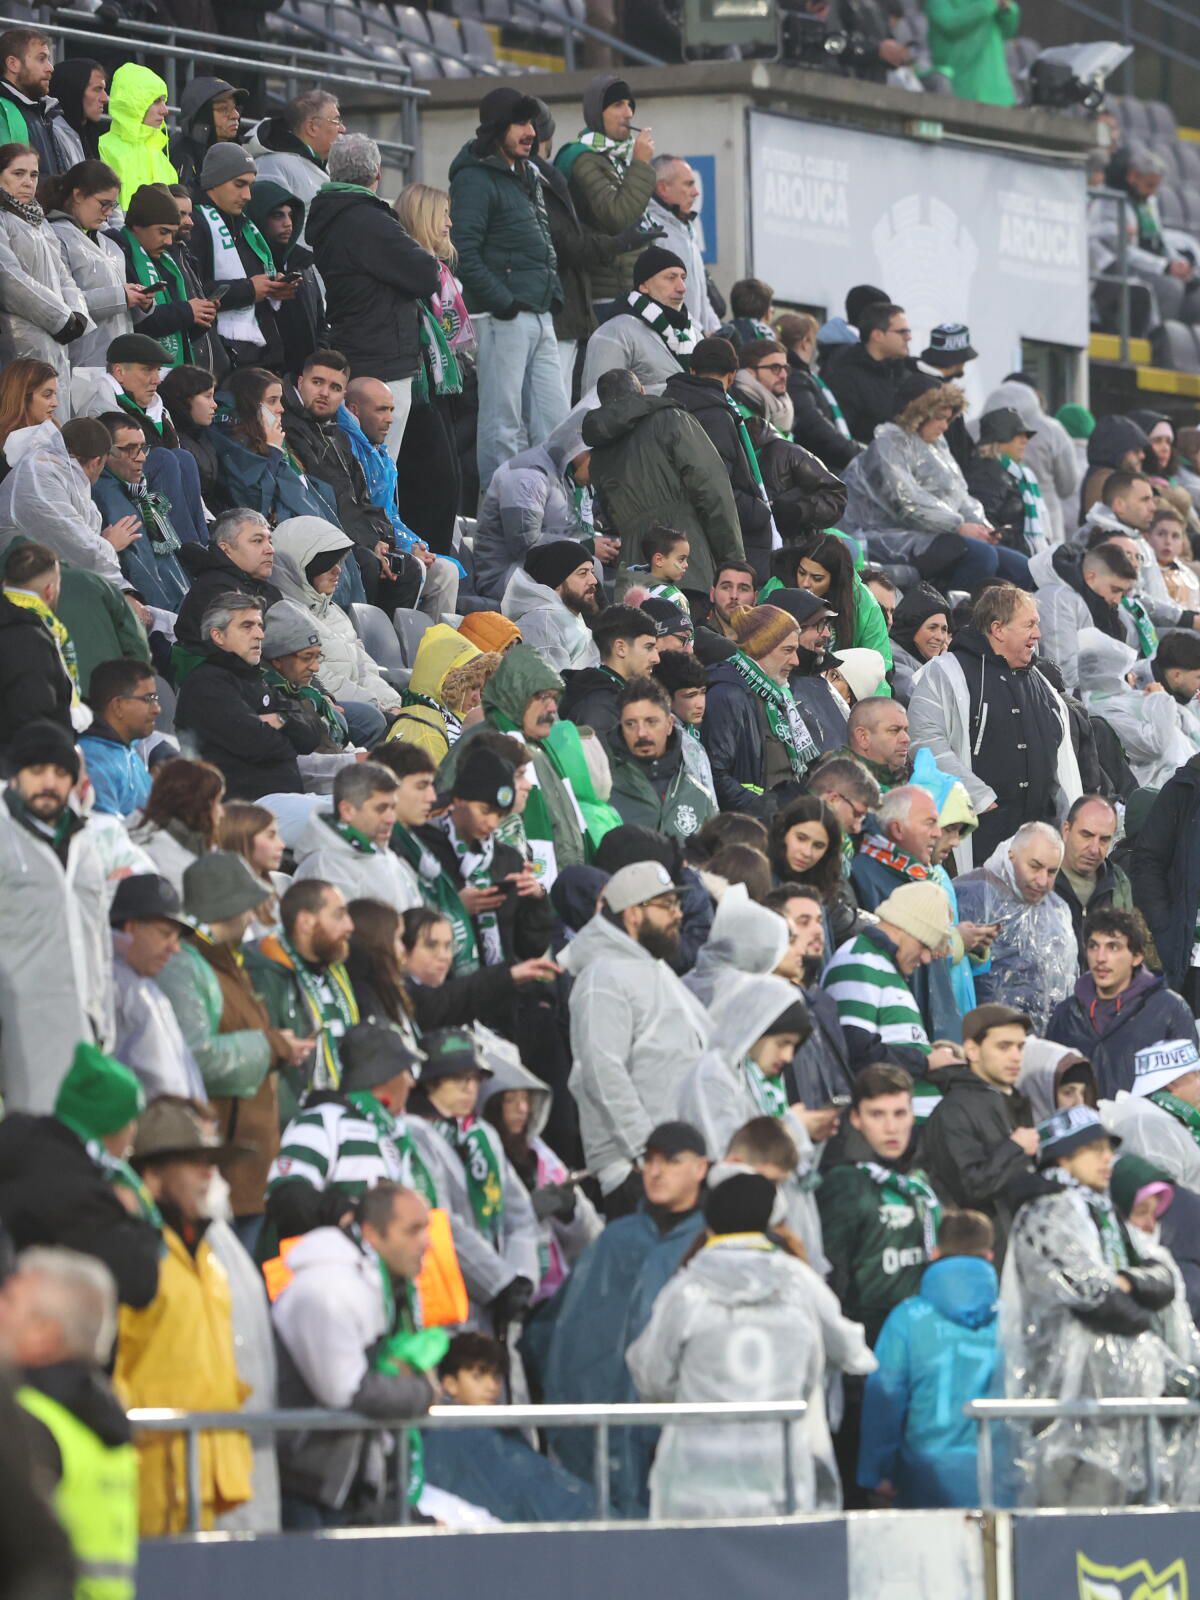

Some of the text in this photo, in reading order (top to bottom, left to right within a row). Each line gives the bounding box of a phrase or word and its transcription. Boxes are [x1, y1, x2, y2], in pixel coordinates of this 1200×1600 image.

[764, 171, 850, 230] AROUCA
[999, 212, 1081, 267] AROUCA
[928, 1340, 996, 1428] 17
